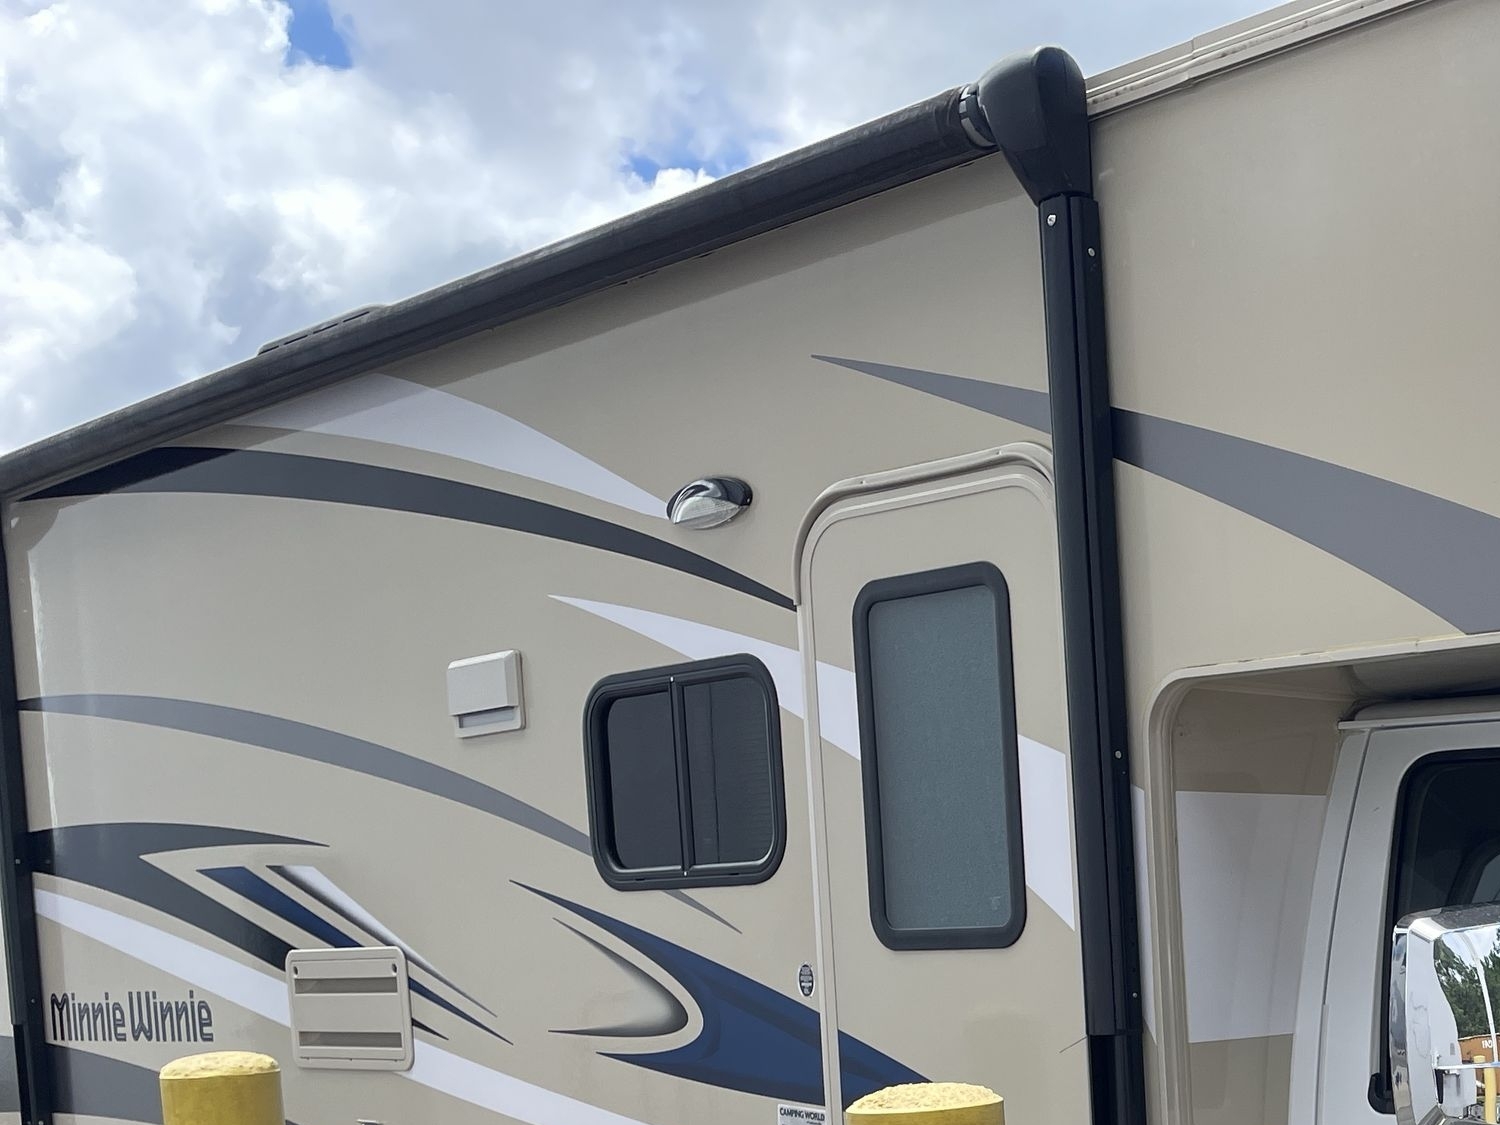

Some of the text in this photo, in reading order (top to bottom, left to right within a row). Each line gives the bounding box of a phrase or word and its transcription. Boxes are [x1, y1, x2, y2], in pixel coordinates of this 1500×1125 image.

[50, 990, 214, 1042] Minnie Winnie
[779, 1107, 825, 1122] CAMPING WORLD
